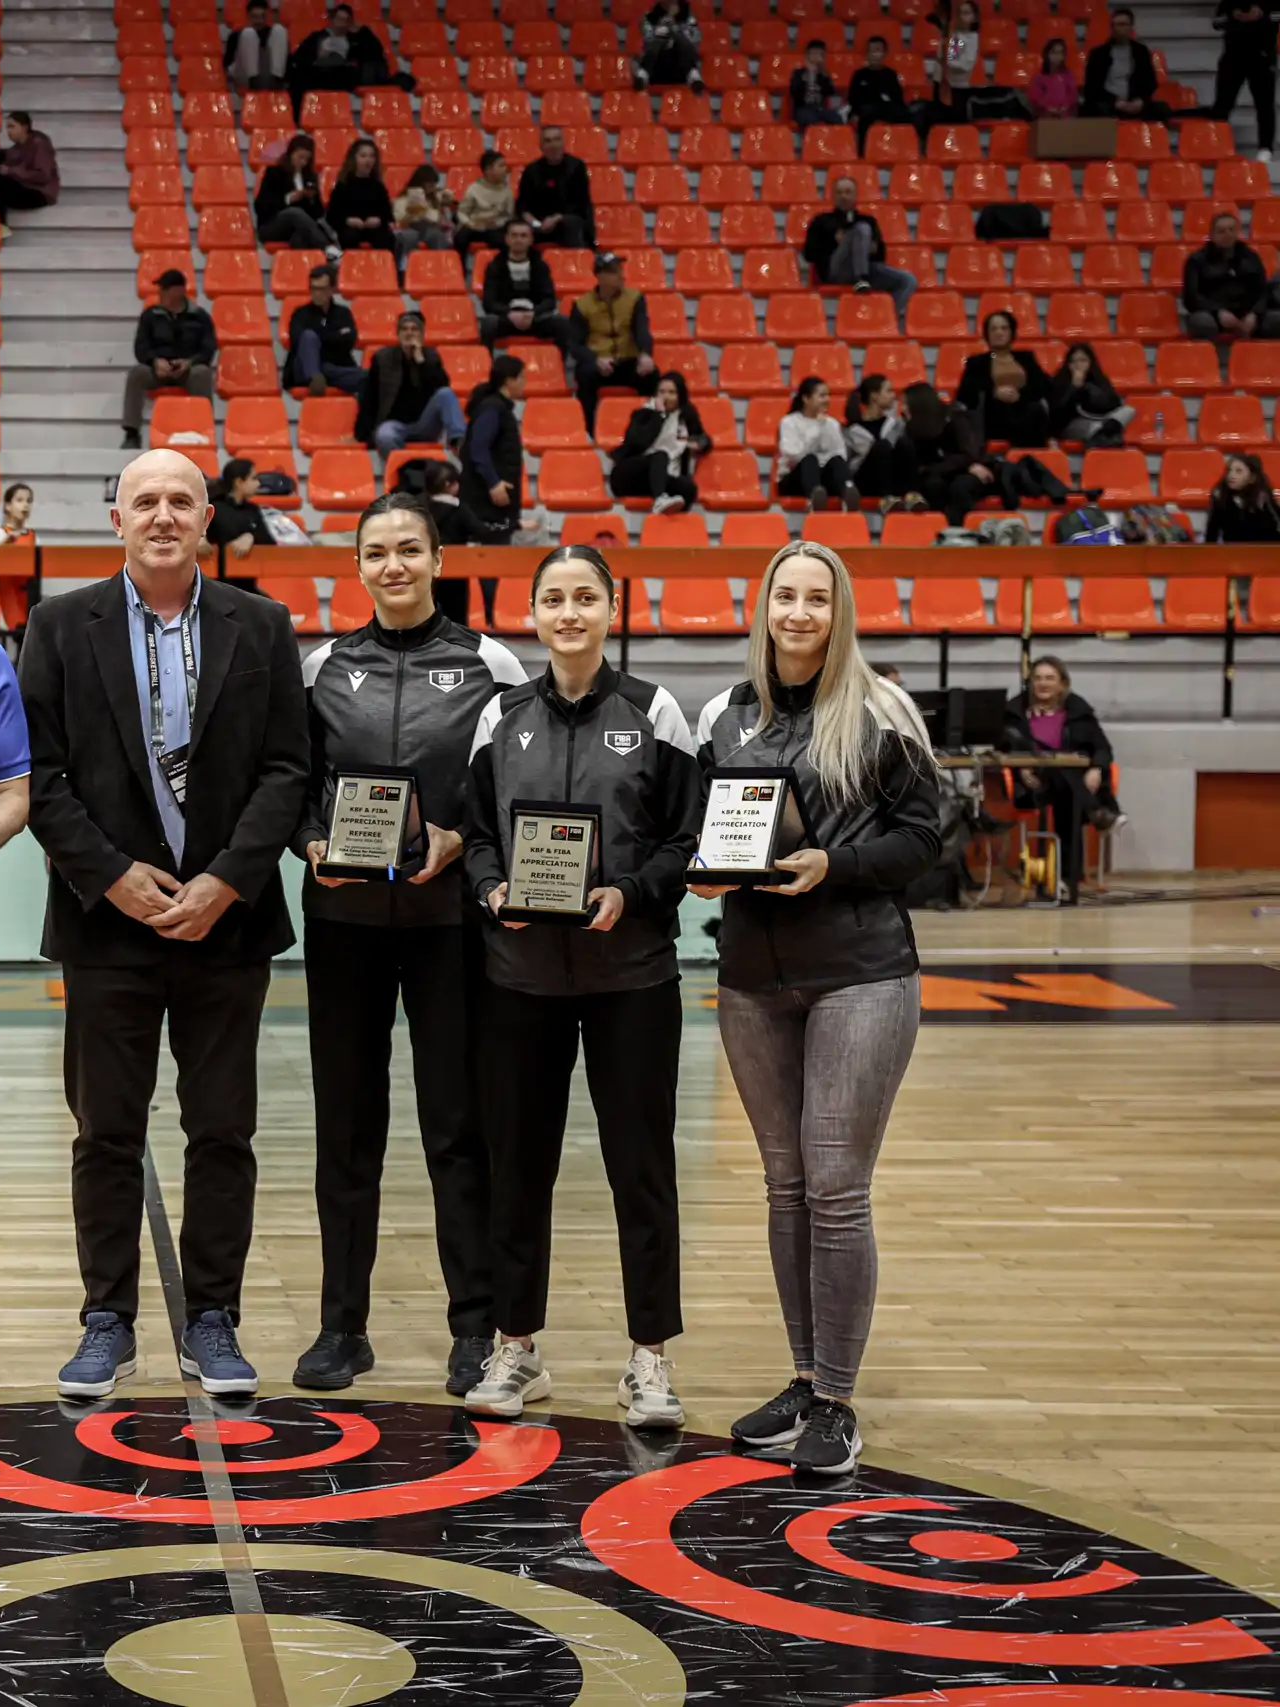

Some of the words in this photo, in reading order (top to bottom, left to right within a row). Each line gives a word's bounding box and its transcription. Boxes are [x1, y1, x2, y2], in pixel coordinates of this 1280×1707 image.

[148, 633, 159, 687] FIBA.BASKETBALL
[615, 735, 631, 743] FIBA
[340, 817, 395, 826] APPRECIATION
[349, 830, 382, 838] REFEREE
[520, 859, 580, 868] APPRECIATION
[531, 872, 566, 880] REFEREE
